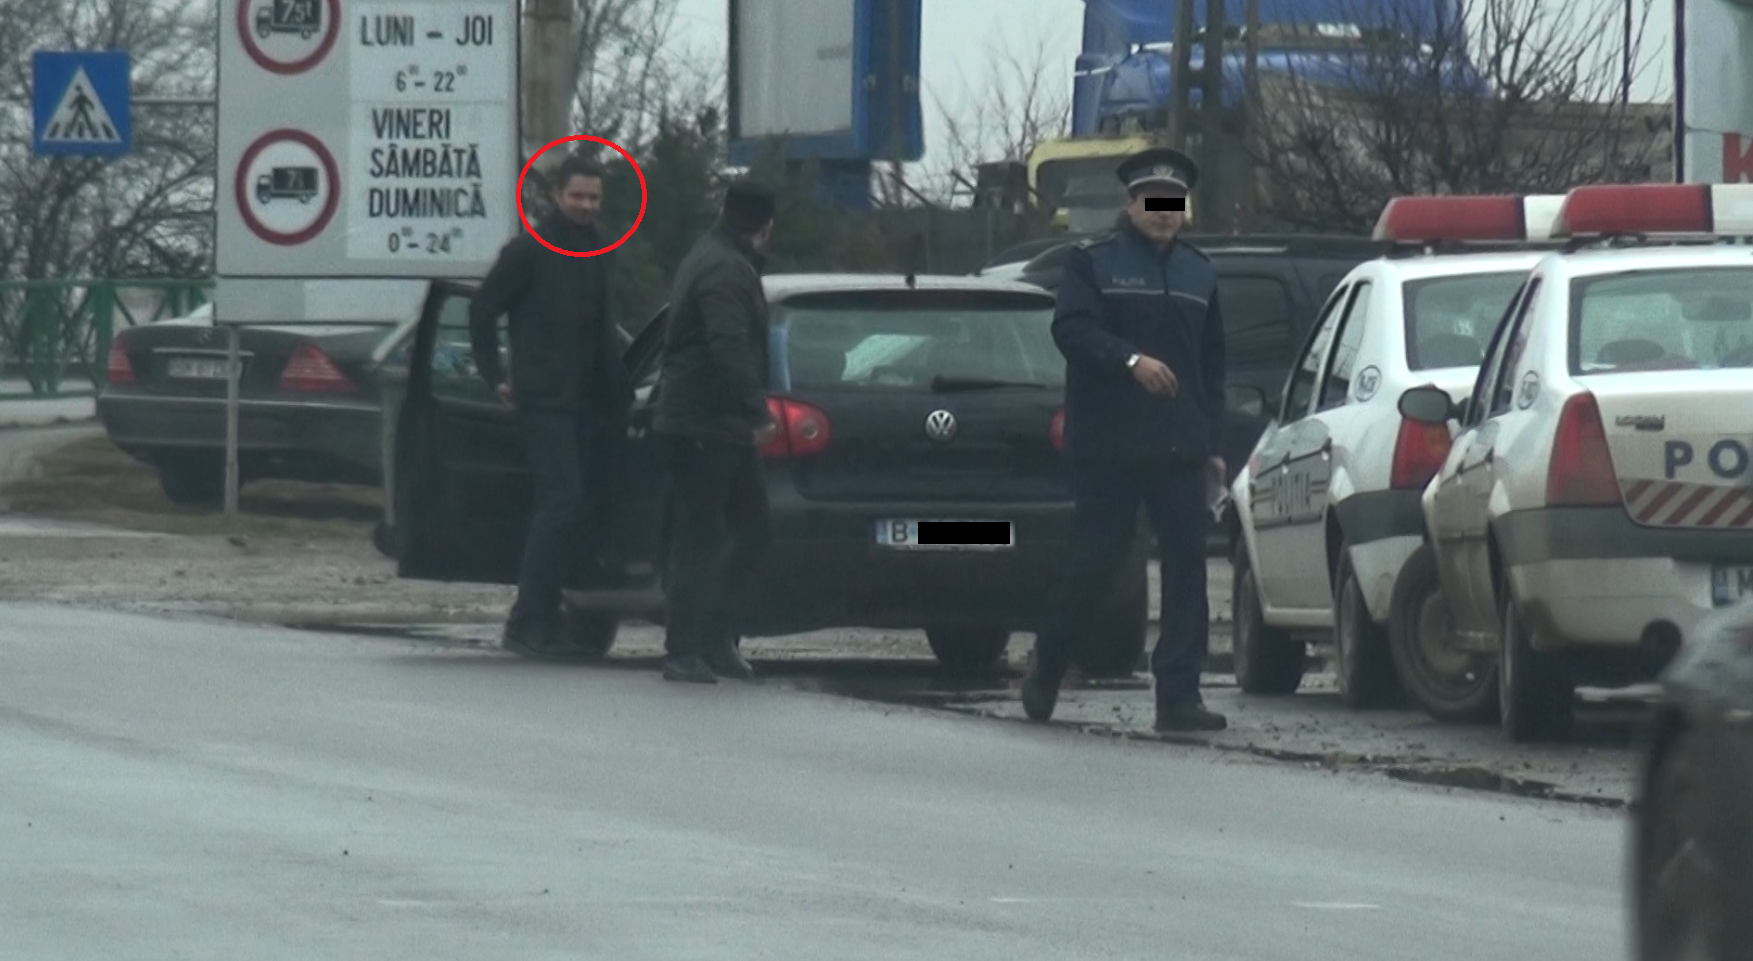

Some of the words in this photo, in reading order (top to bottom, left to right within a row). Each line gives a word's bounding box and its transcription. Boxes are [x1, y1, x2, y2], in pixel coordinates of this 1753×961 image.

[360, 15, 415, 46] LUNI
[456, 15, 493, 46] JOI
[372, 108, 450, 140] VINERI
[369, 143, 483, 179] SÂMBĂTĂ
[368, 182, 487, 219] DUMINICĂ
[891, 520, 908, 543] B
